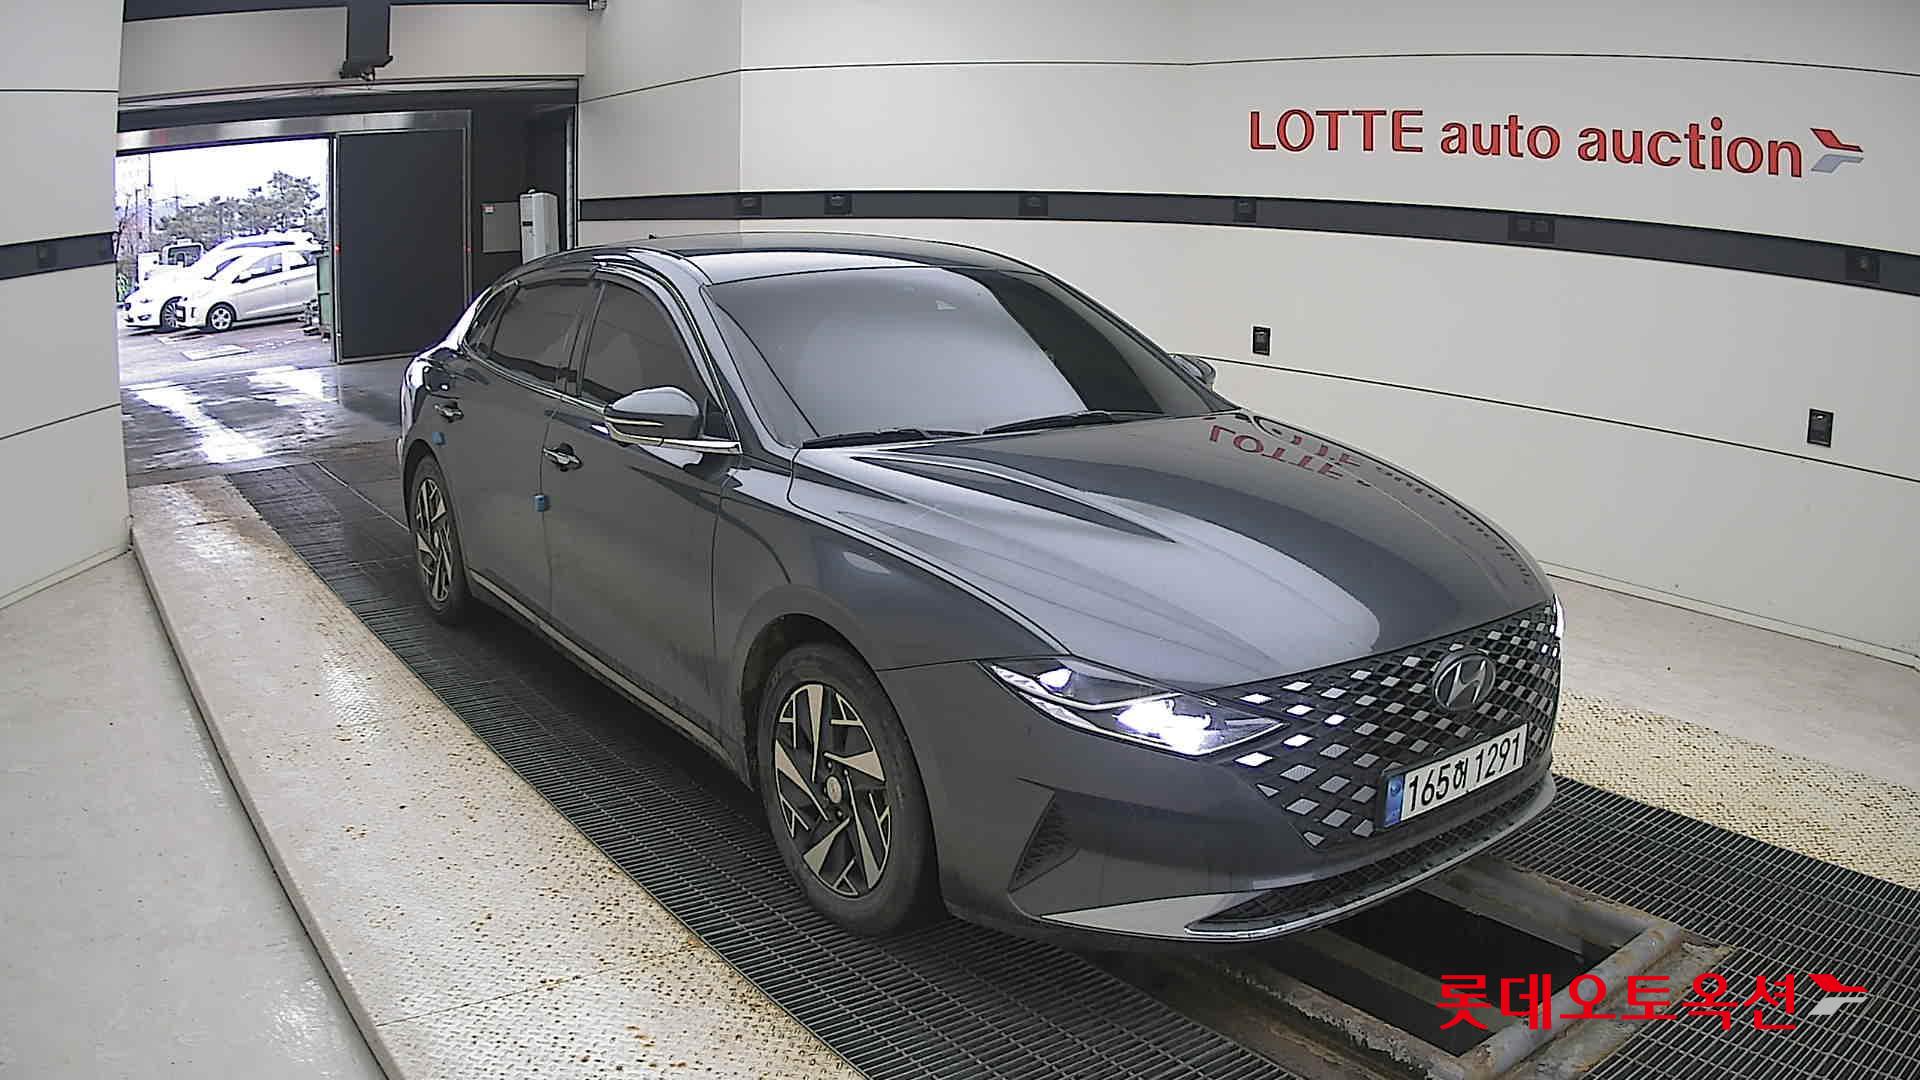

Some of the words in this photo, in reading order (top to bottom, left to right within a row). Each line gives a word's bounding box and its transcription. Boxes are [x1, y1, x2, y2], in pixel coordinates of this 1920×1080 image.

[1249, 110, 1423, 153] LOTTE
[1440, 115, 1561, 159] auto
[1577, 117, 1802, 177] auction
[1408, 757, 1469, 812] 165허
[1475, 732, 1521, 783] 1291
